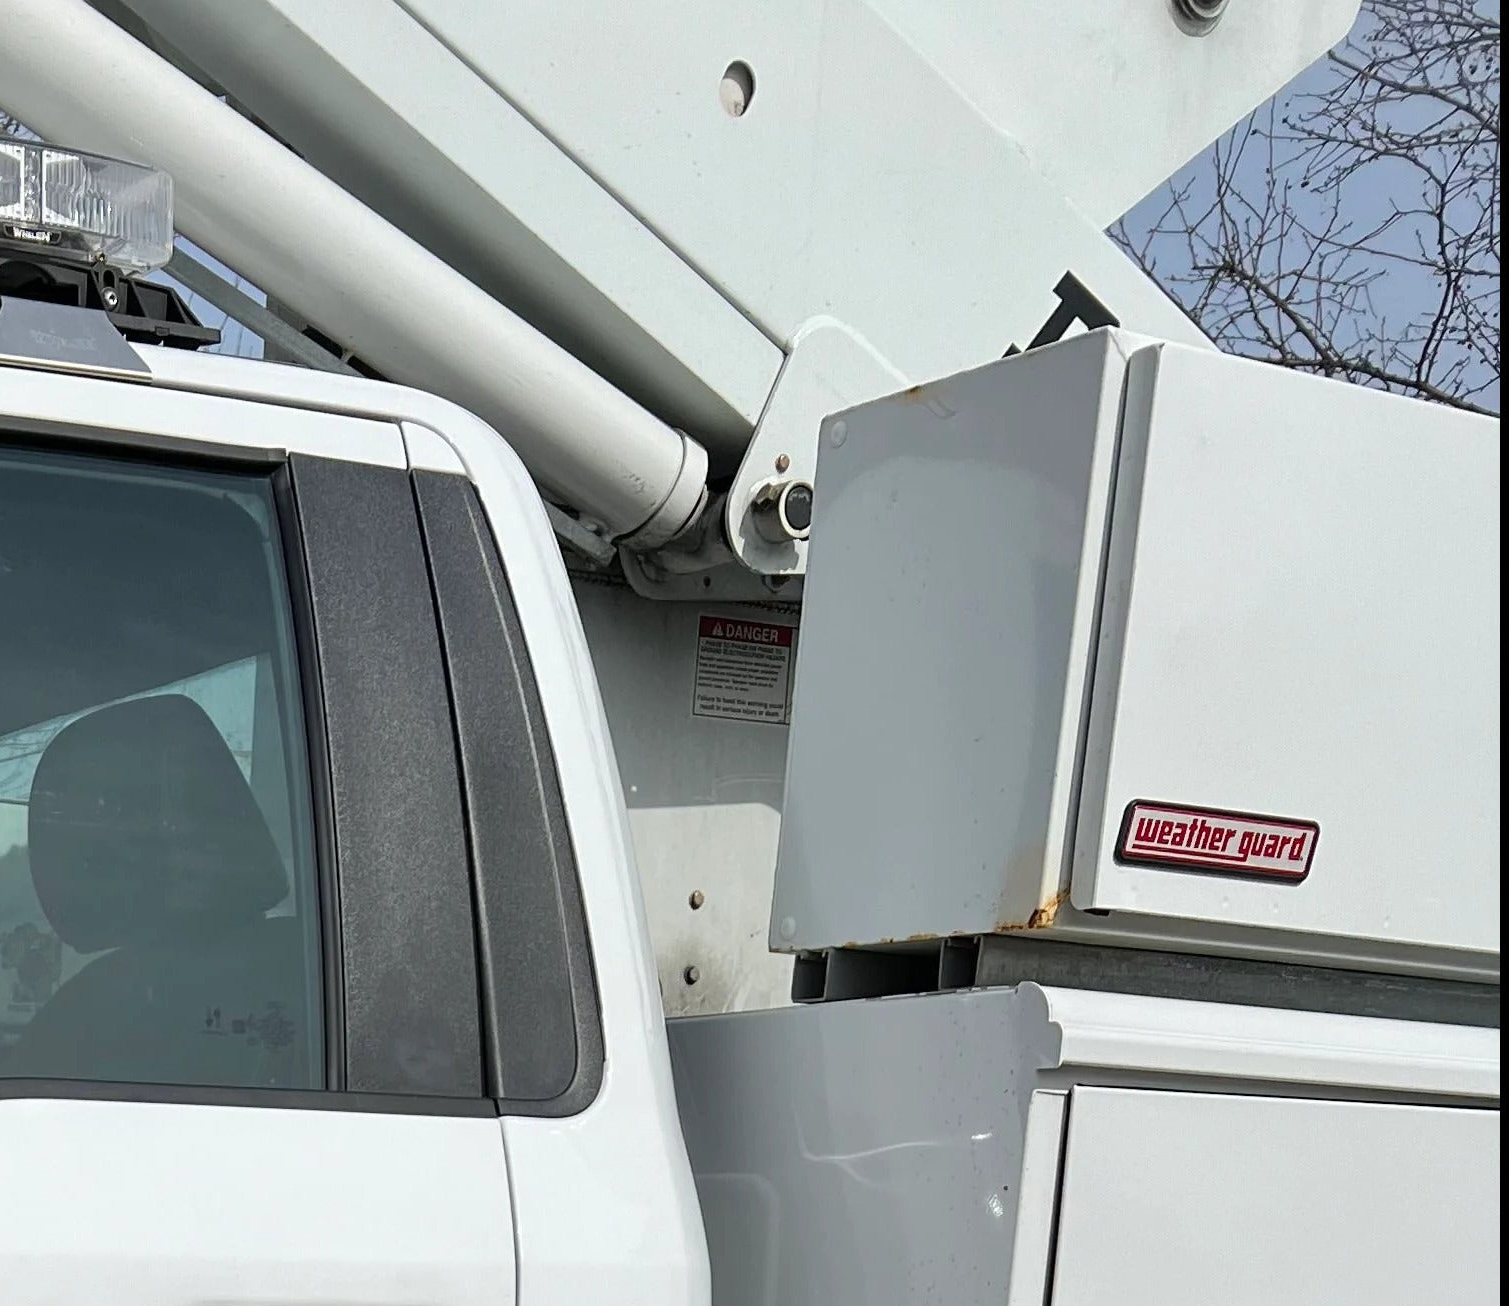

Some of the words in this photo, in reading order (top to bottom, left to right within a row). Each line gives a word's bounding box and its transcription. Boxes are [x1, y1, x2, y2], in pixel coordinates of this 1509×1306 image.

[726, 623, 779, 643] DANGER
[1135, 817, 1237, 852] weather
[1237, 831, 1308, 862] guard
